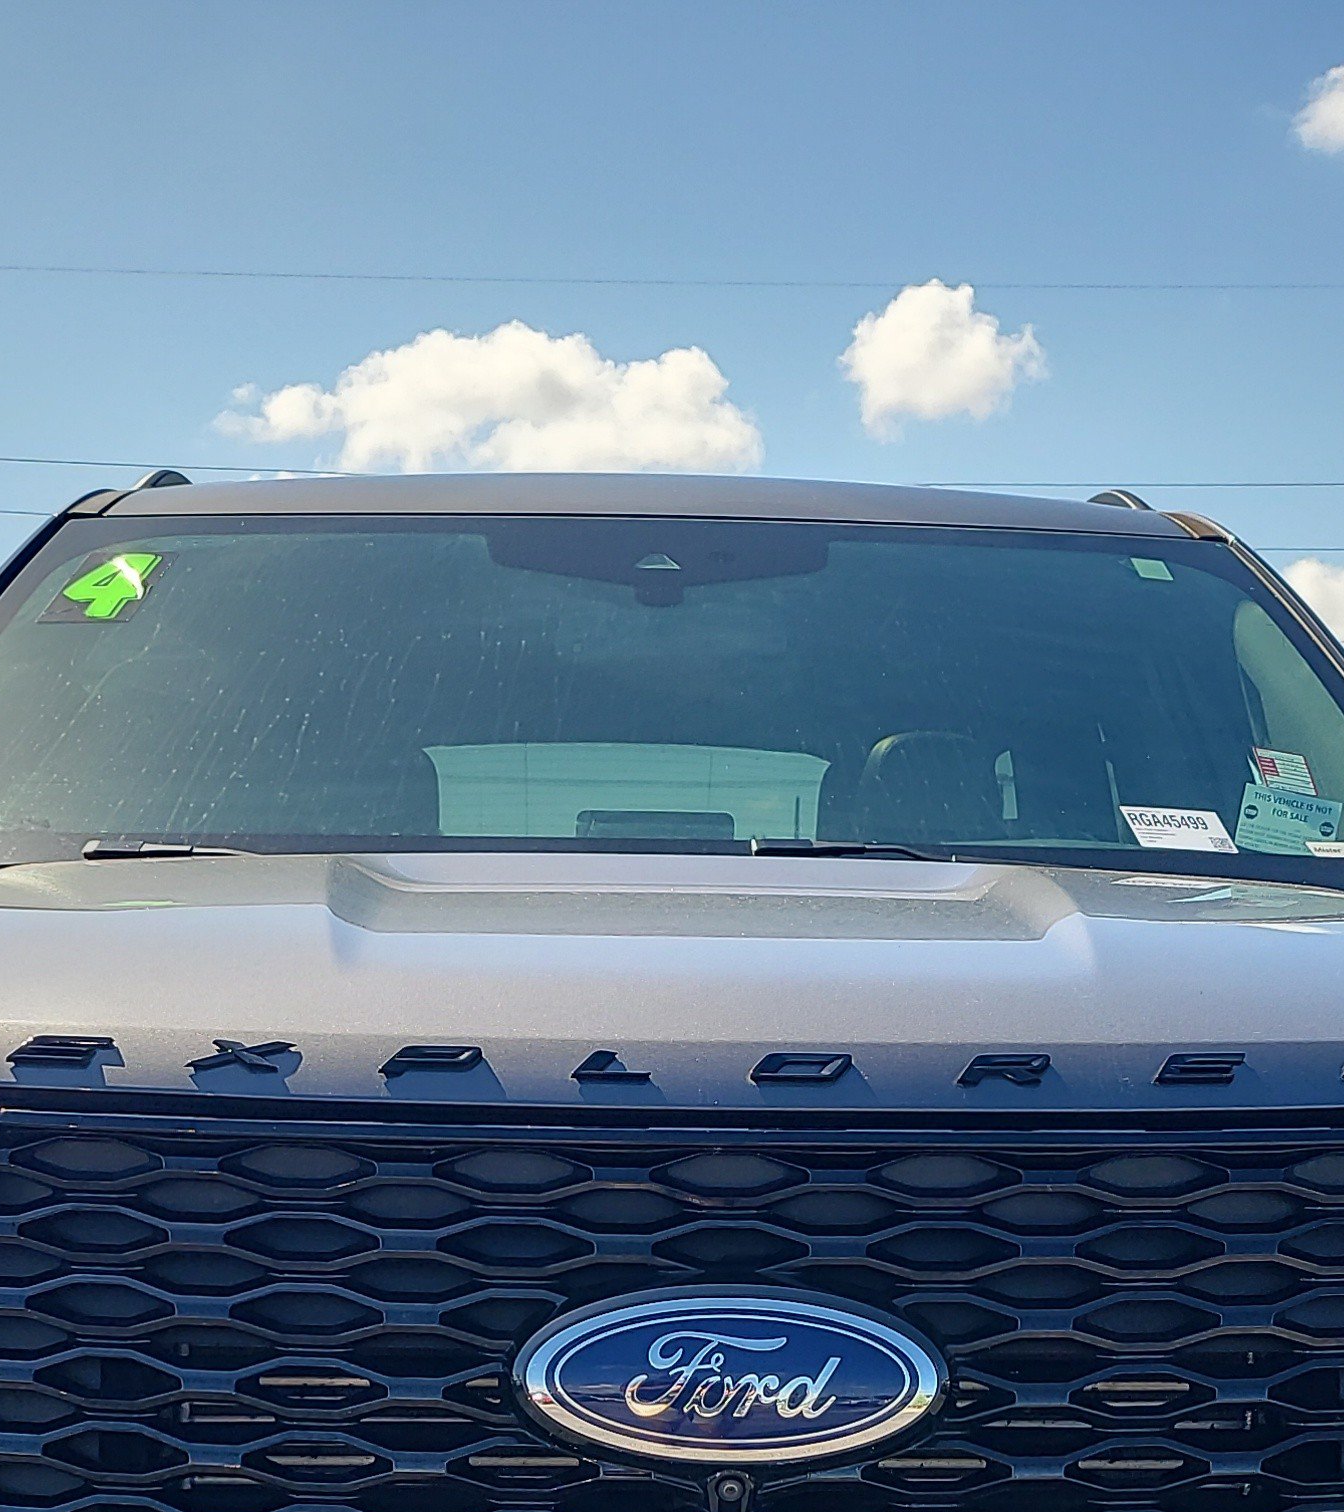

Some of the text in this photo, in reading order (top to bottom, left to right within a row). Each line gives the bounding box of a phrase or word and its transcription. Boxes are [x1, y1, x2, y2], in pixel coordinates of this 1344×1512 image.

[62, 552, 163, 619] 4
[1254, 791, 1333, 815] THIS VEHICLE IS NOT
[1126, 812, 1209, 831] RGA45499
[1271, 808, 1288, 819] FOR
[1289, 812, 1309, 823] SALE
[624, 1330, 841, 1420] Ford
